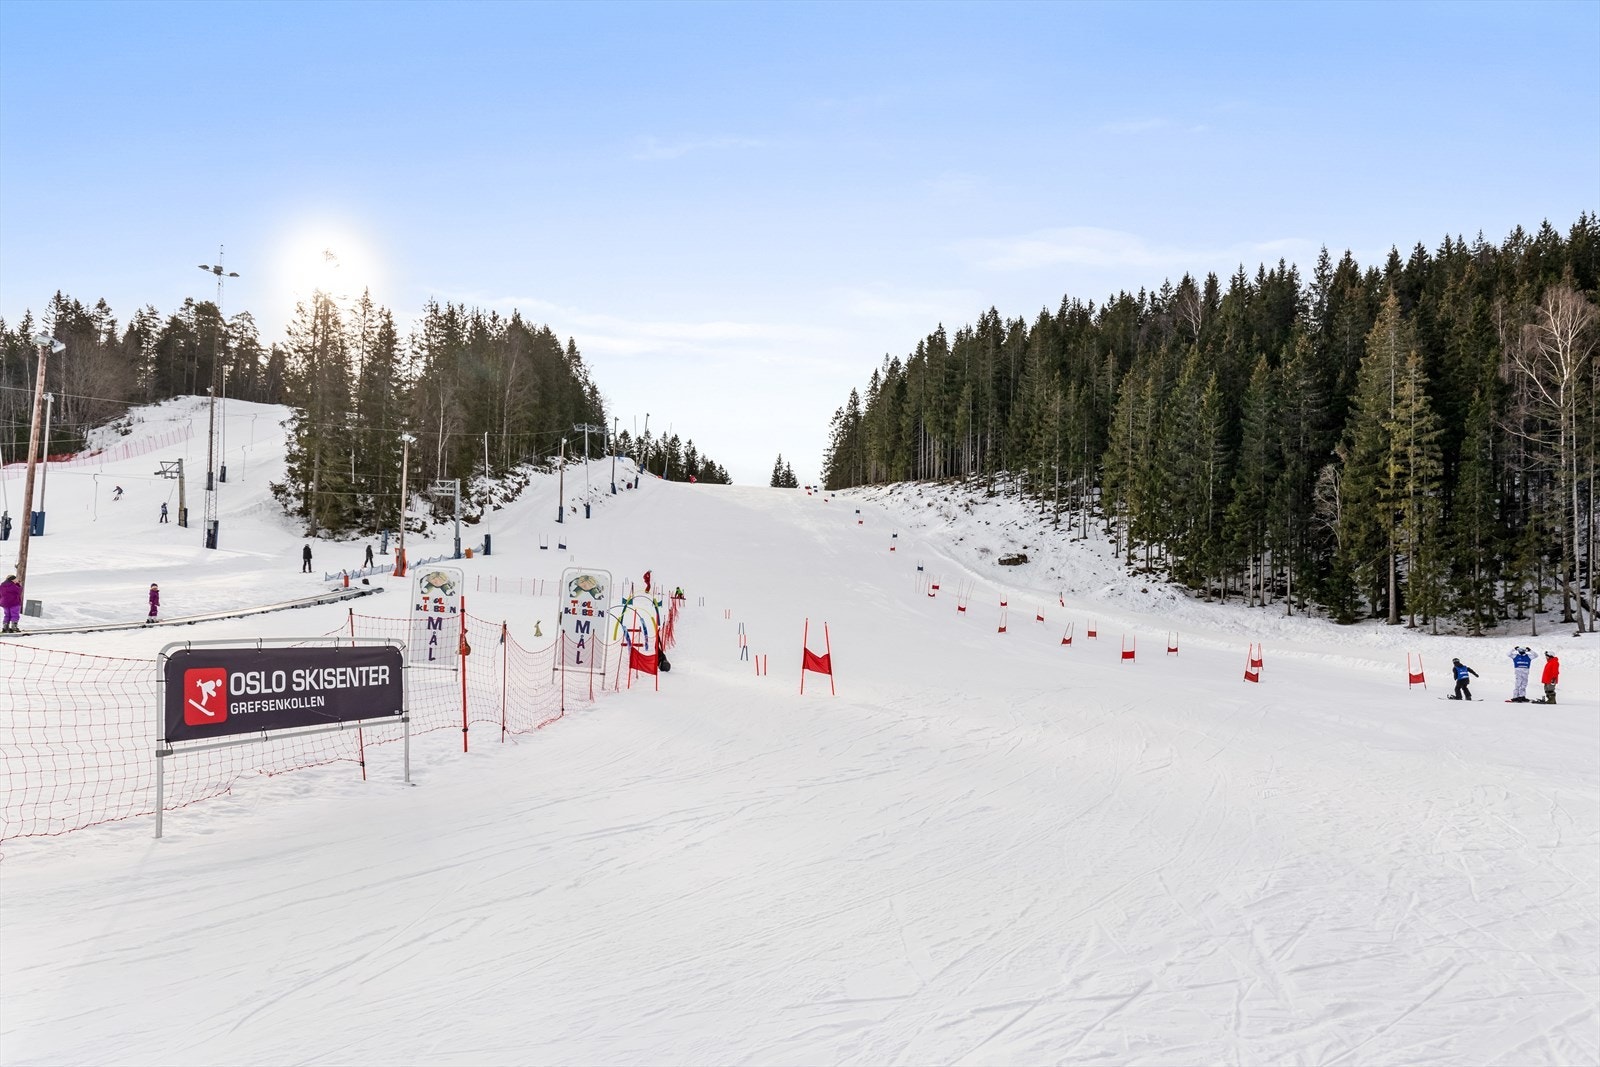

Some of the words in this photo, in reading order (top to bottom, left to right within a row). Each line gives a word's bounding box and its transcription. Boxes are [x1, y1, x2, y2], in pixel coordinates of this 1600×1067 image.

[427, 616, 443, 662] MÅL
[575, 620, 591, 665] MÅL
[229, 670, 287, 696] OSLO
[292, 665, 390, 692] SKISENTER
[230, 695, 325, 715] GREFSENKOLLEN
